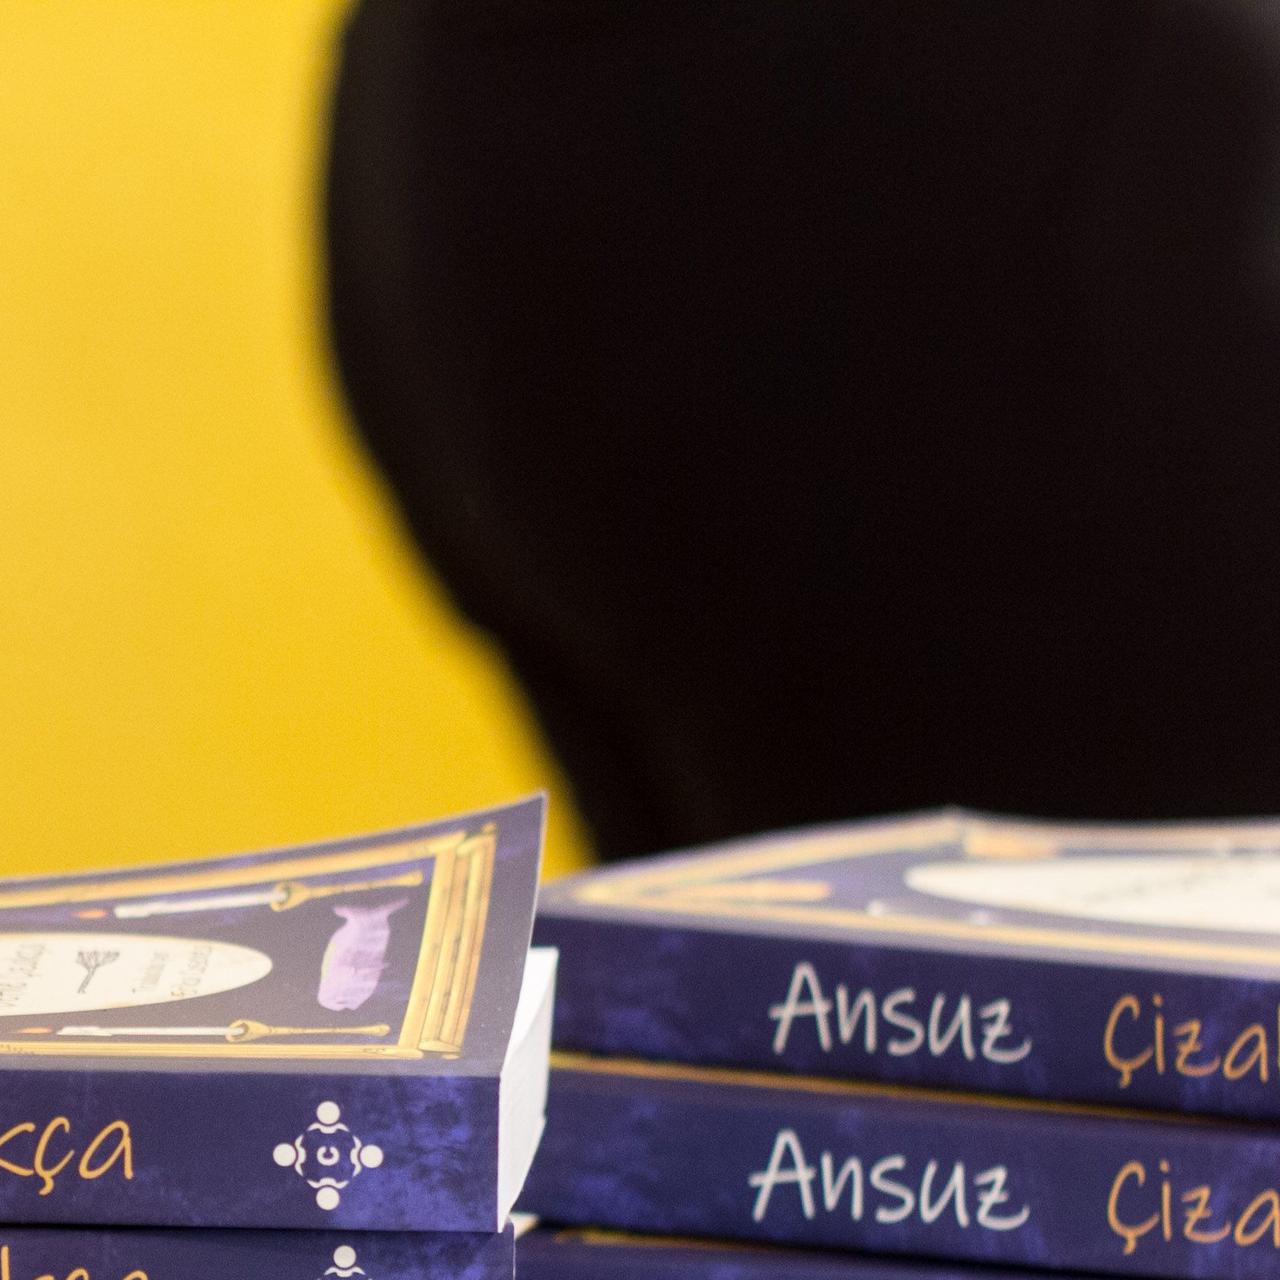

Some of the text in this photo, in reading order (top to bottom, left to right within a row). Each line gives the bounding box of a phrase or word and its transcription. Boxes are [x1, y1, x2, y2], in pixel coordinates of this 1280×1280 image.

[767, 959, 1280, 1088] Ansuz Çiza
[748, 1129, 1031, 1232] Ansuz
